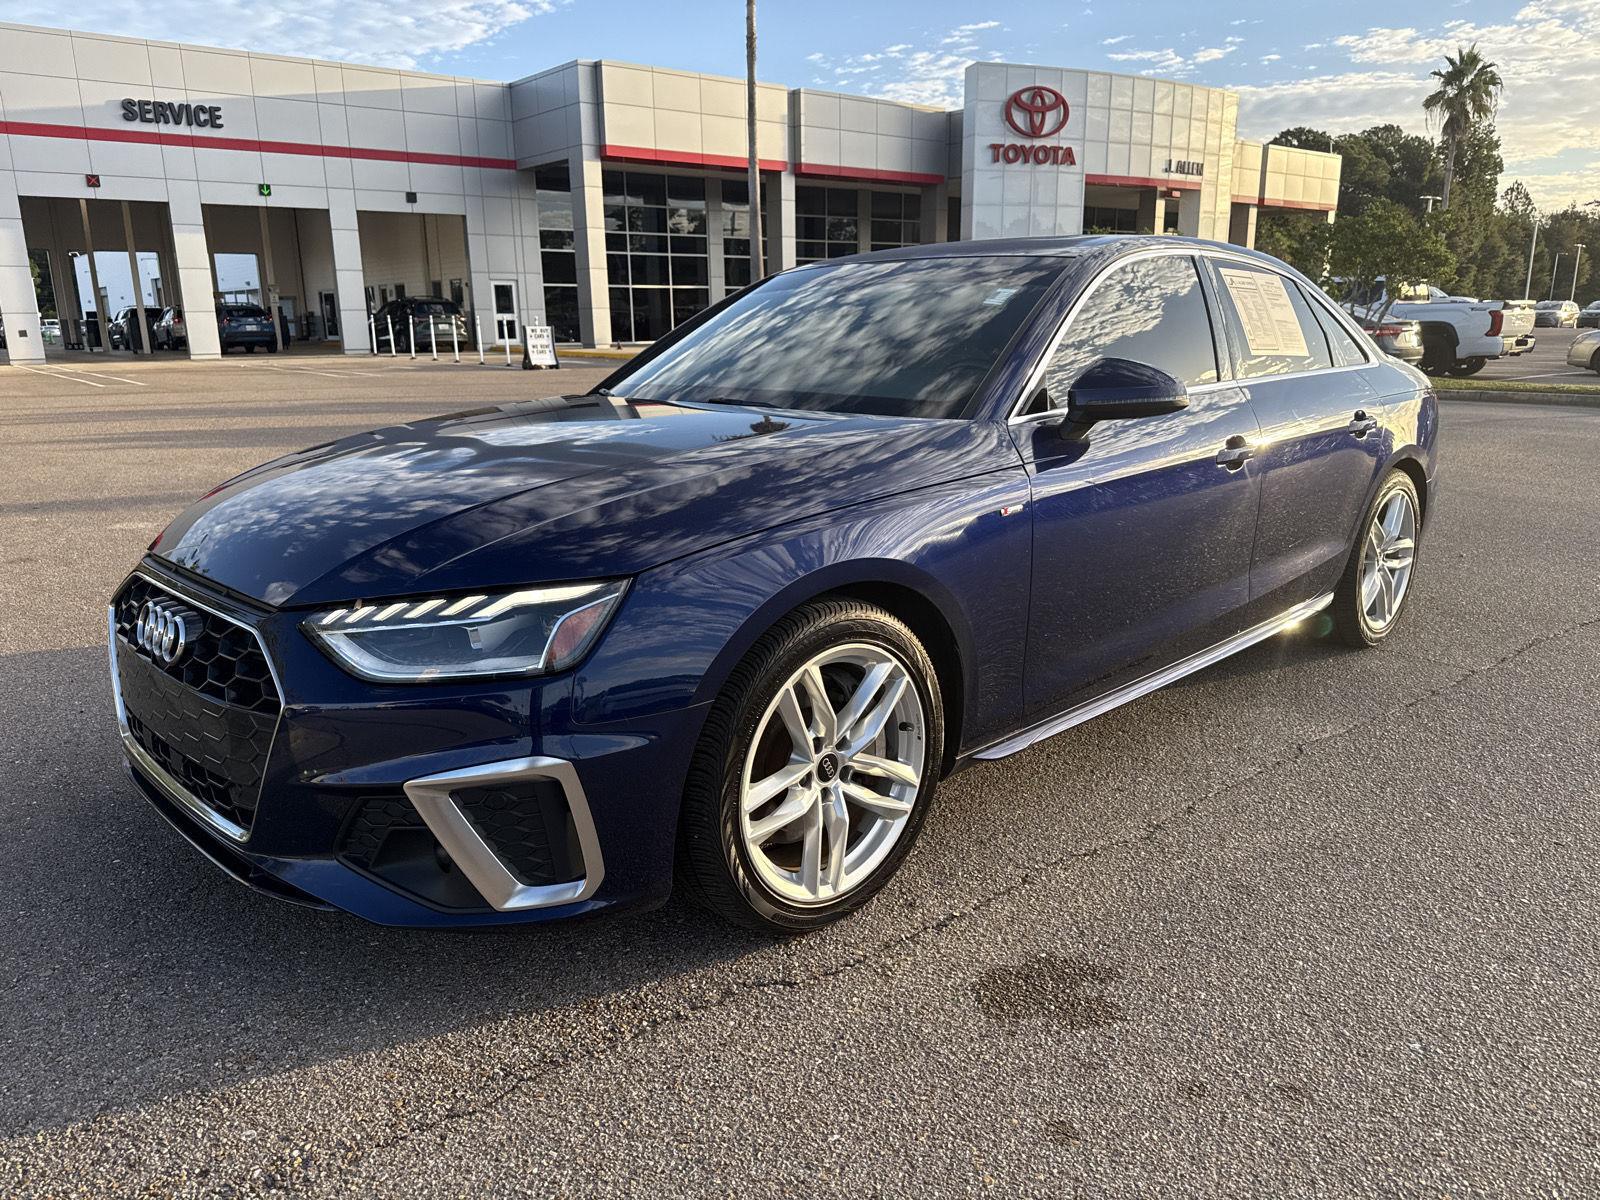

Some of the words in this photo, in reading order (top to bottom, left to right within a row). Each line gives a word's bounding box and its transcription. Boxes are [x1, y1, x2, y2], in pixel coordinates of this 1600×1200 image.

[121, 98, 224, 128] SERVICE
[989, 143, 1076, 166] TOYOTA
[1175, 160, 1204, 176] ALLEN
